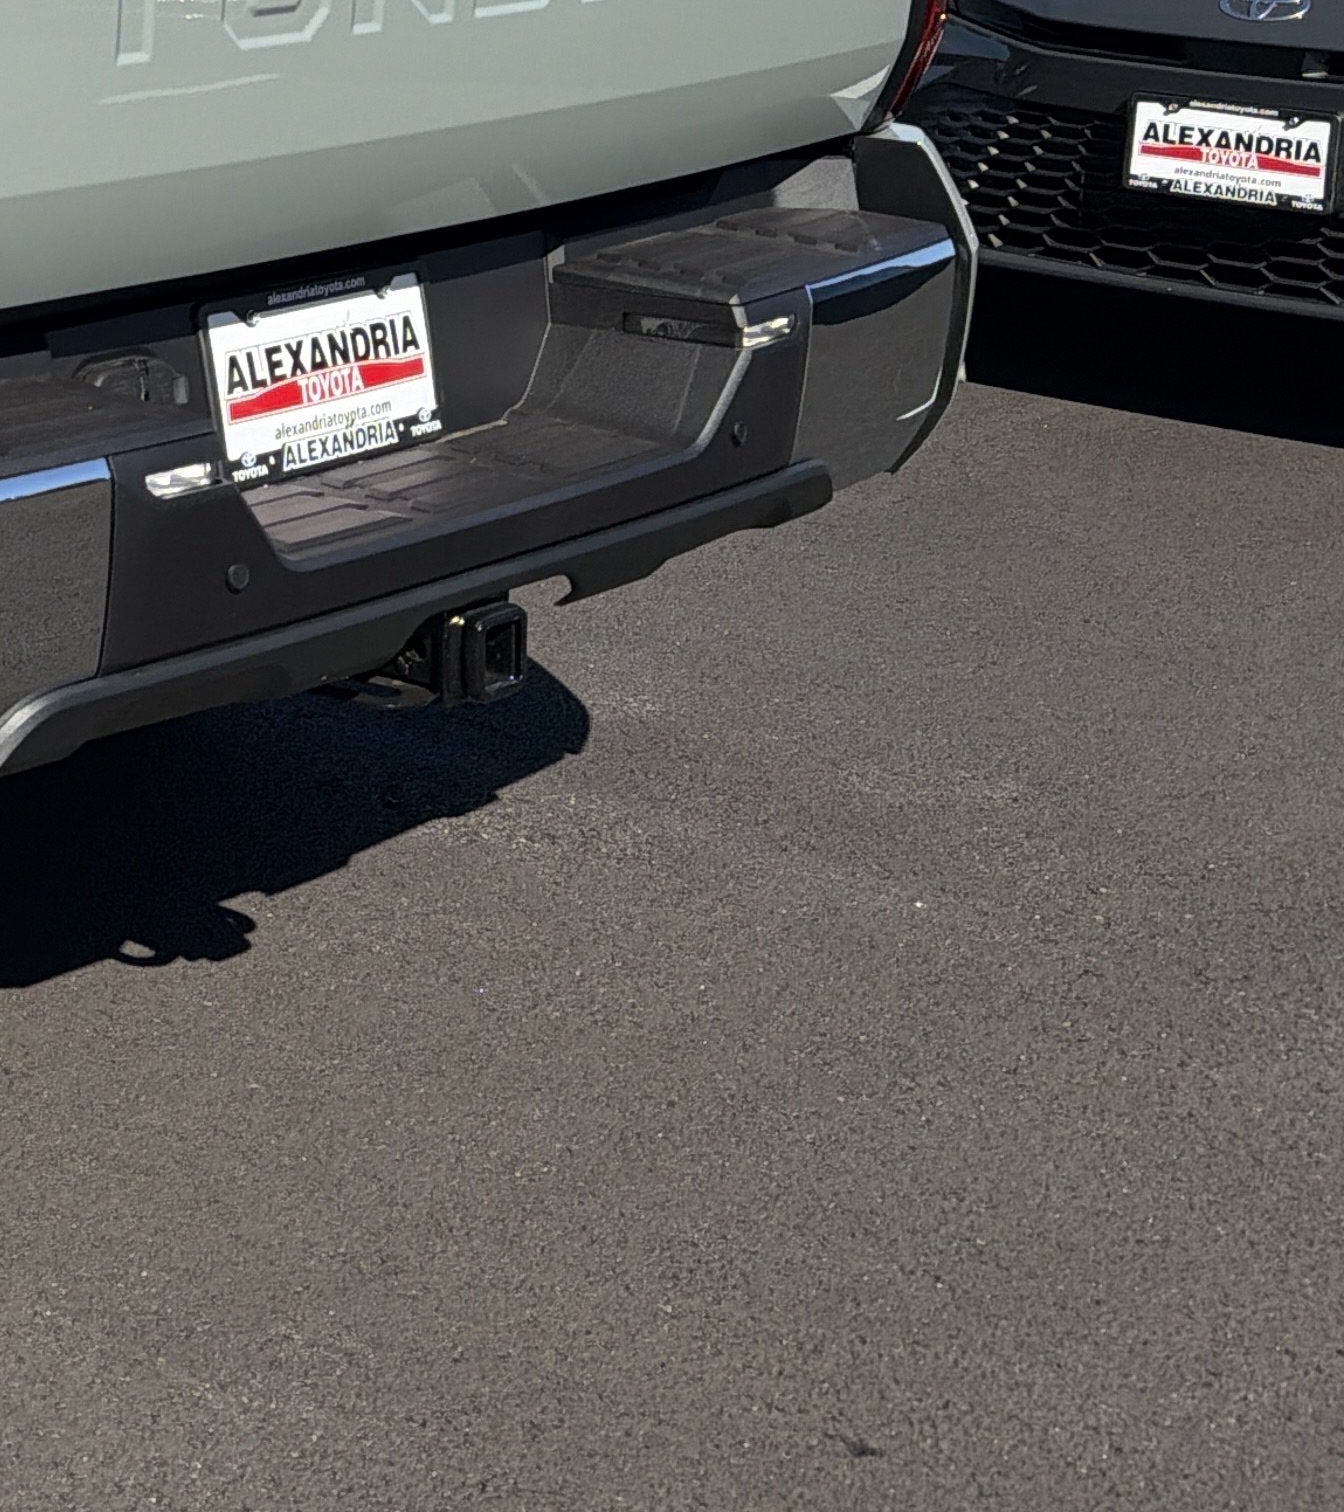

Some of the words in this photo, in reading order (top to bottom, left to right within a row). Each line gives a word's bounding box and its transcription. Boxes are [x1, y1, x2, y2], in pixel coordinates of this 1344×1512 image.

[1142, 121, 1322, 164] ALEXANDRIA
[1200, 148, 1259, 170] TOYOTA
[1171, 178, 1278, 207] ALEXANDRIA
[1174, 165, 1282, 188] alexandriatoyota.com
[267, 275, 366, 306] alexandriatoyota.com
[225, 313, 420, 396] ALEXANDRIA
[297, 364, 364, 404] TOYOTA
[274, 400, 392, 440] alexandriatoyota.com
[232, 462, 269, 483] TOYOTA
[282, 418, 399, 471] ALEXANDRIA
[410, 418, 442, 437] TOYOTA
